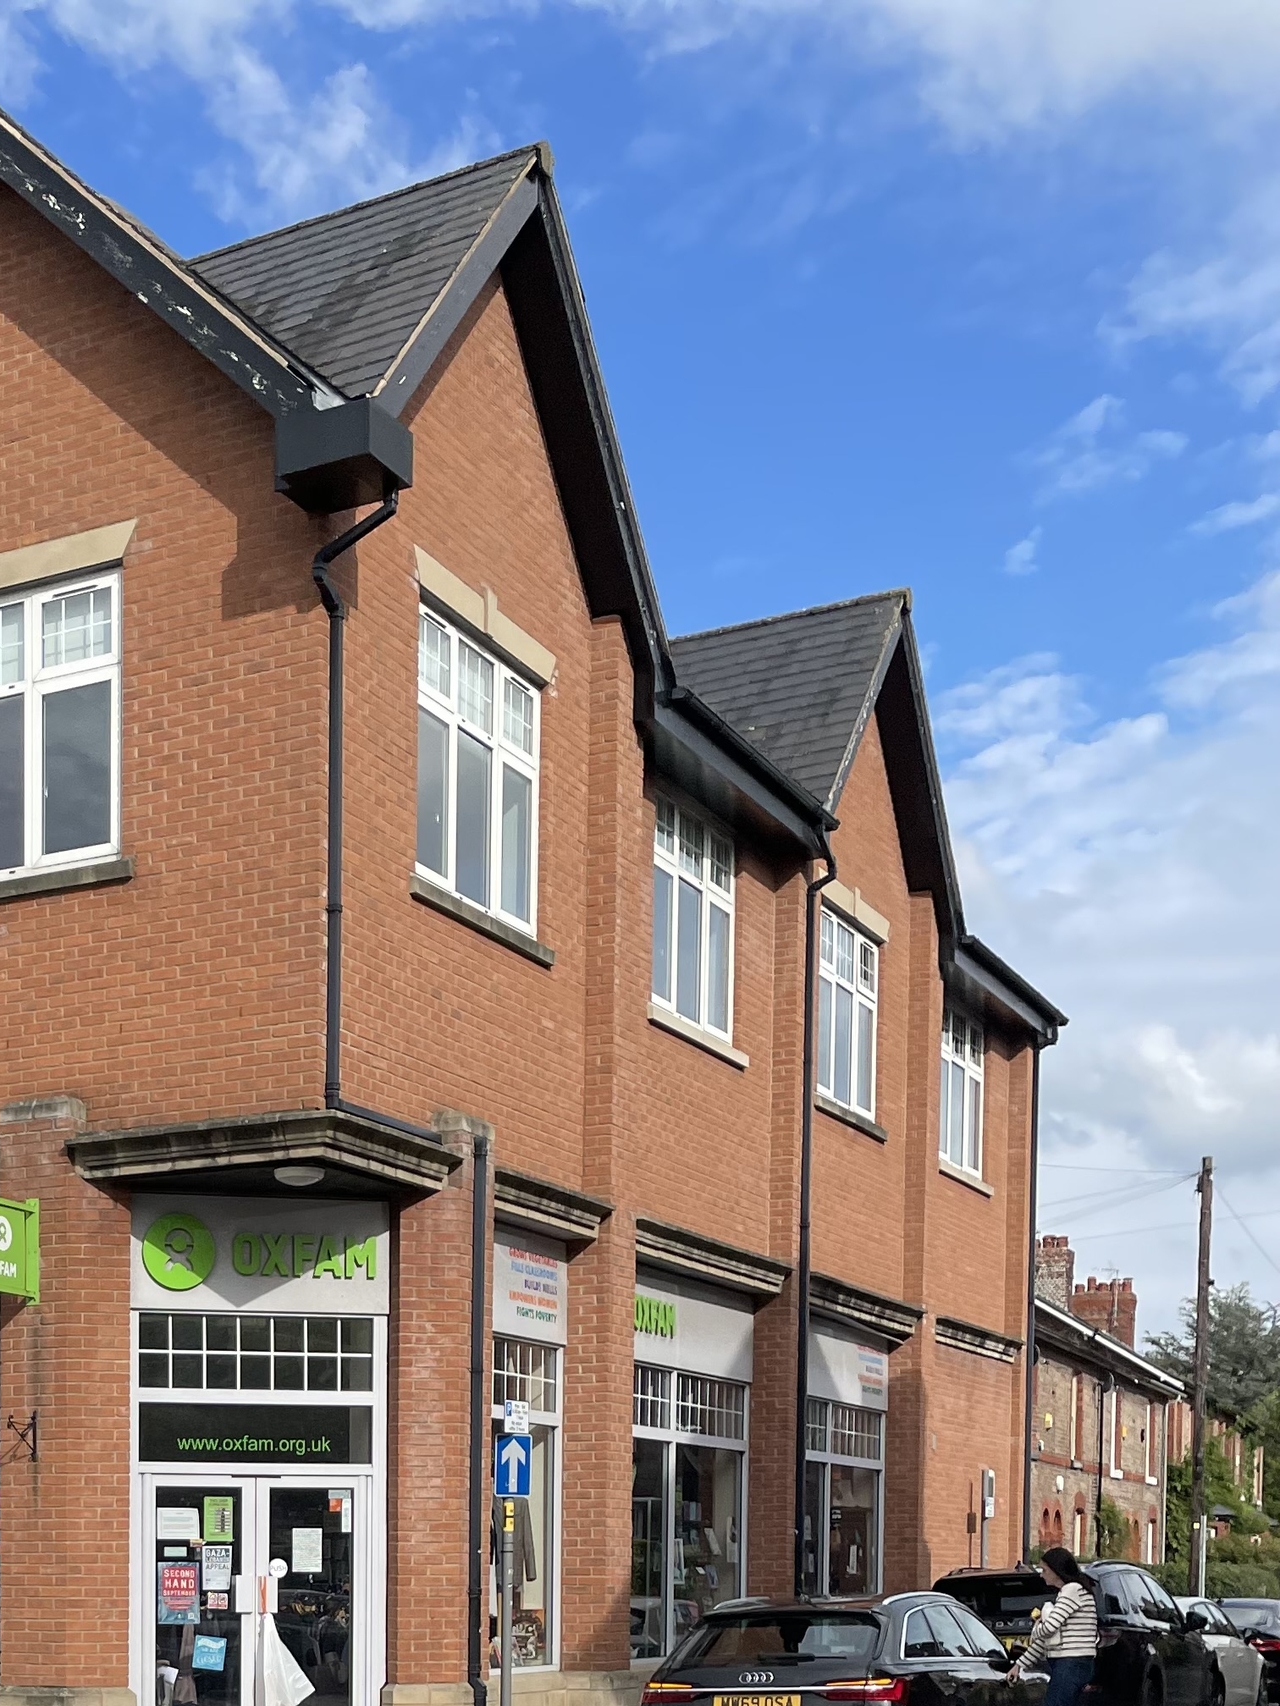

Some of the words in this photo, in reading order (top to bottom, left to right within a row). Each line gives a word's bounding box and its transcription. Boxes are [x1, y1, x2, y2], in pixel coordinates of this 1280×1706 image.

[232, 1232, 377, 1280] OXFAM
[634, 1294, 676, 1338] OXFAM
[176, 1435, 331, 1456] www.oxfam.org.uk
[164, 1570, 195, 1578] SECOND
[164, 1579, 195, 1588] HAND
